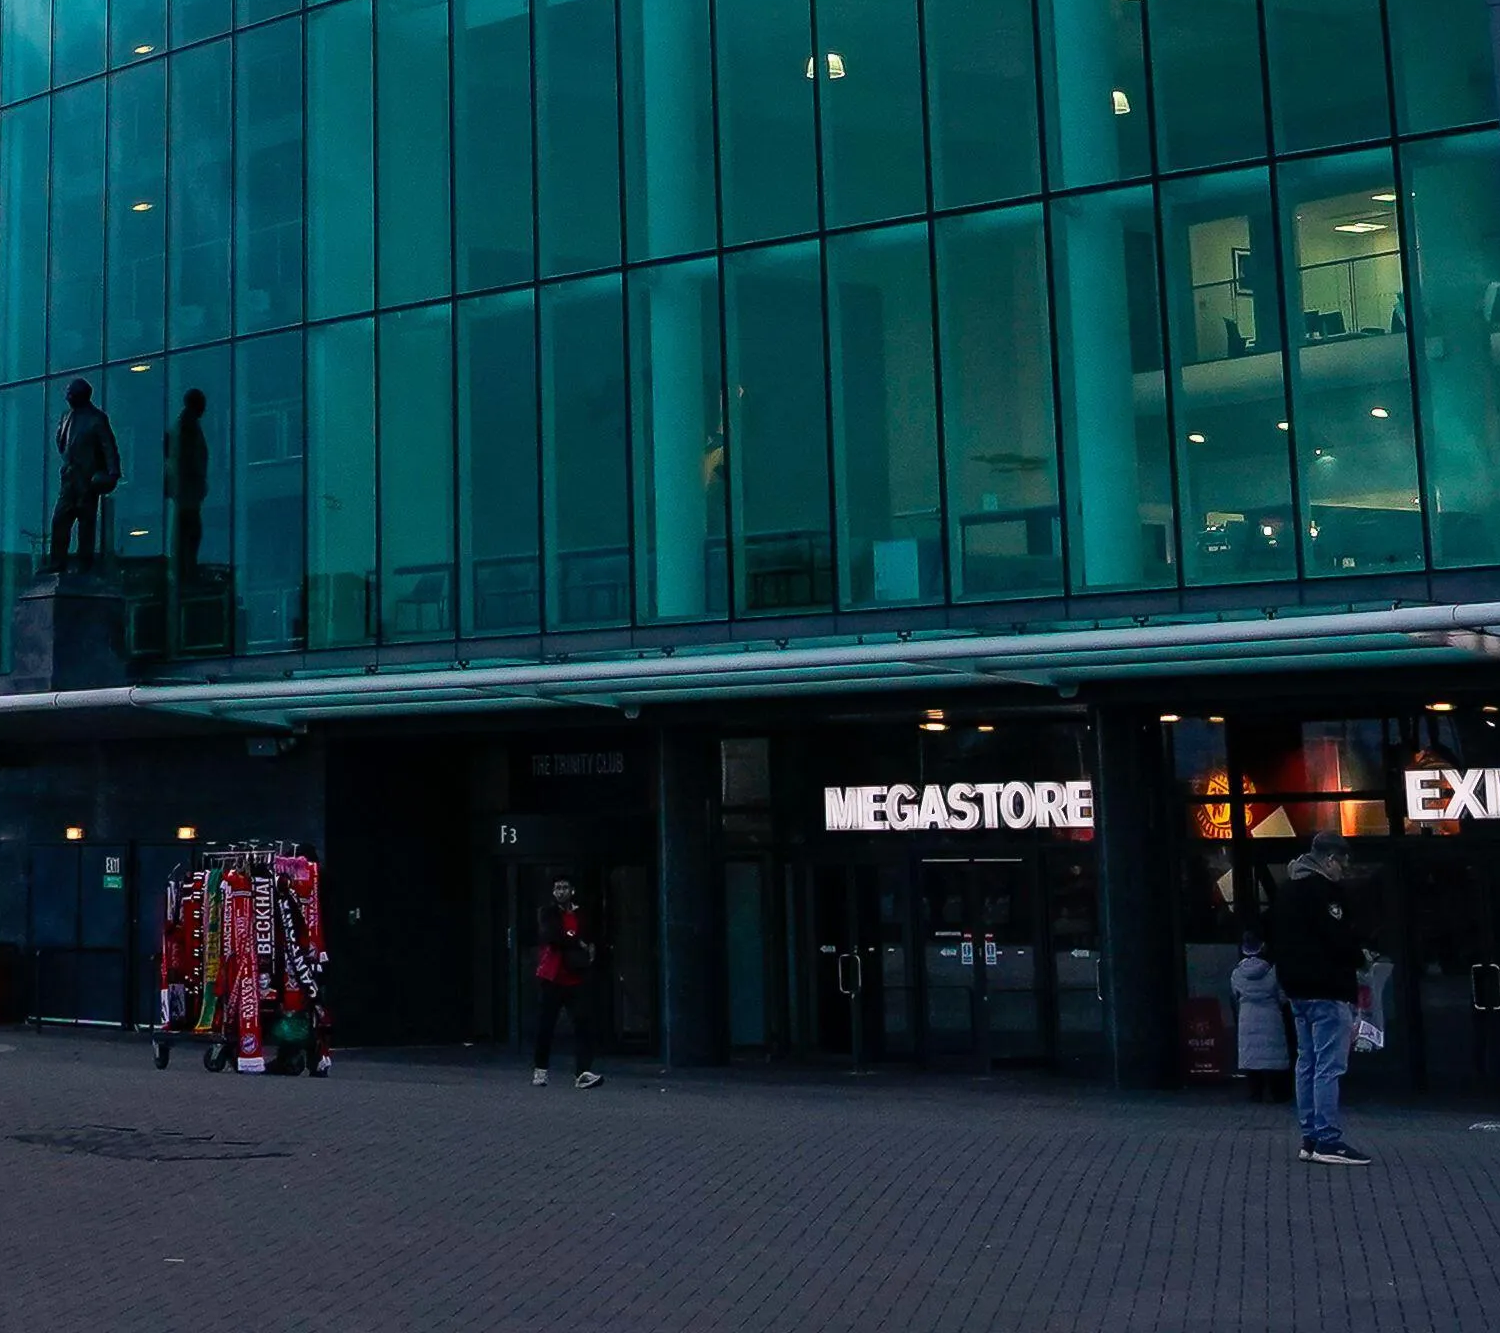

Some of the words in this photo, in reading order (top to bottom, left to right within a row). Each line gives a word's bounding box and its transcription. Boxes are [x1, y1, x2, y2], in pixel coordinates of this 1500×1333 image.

[531, 754, 550, 776] THE
[553, 753, 594, 774] TRINITY
[596, 750, 625, 774] CLUB
[824, 780, 1095, 831] MEGASTORE
[500, 825, 518, 844] F3
